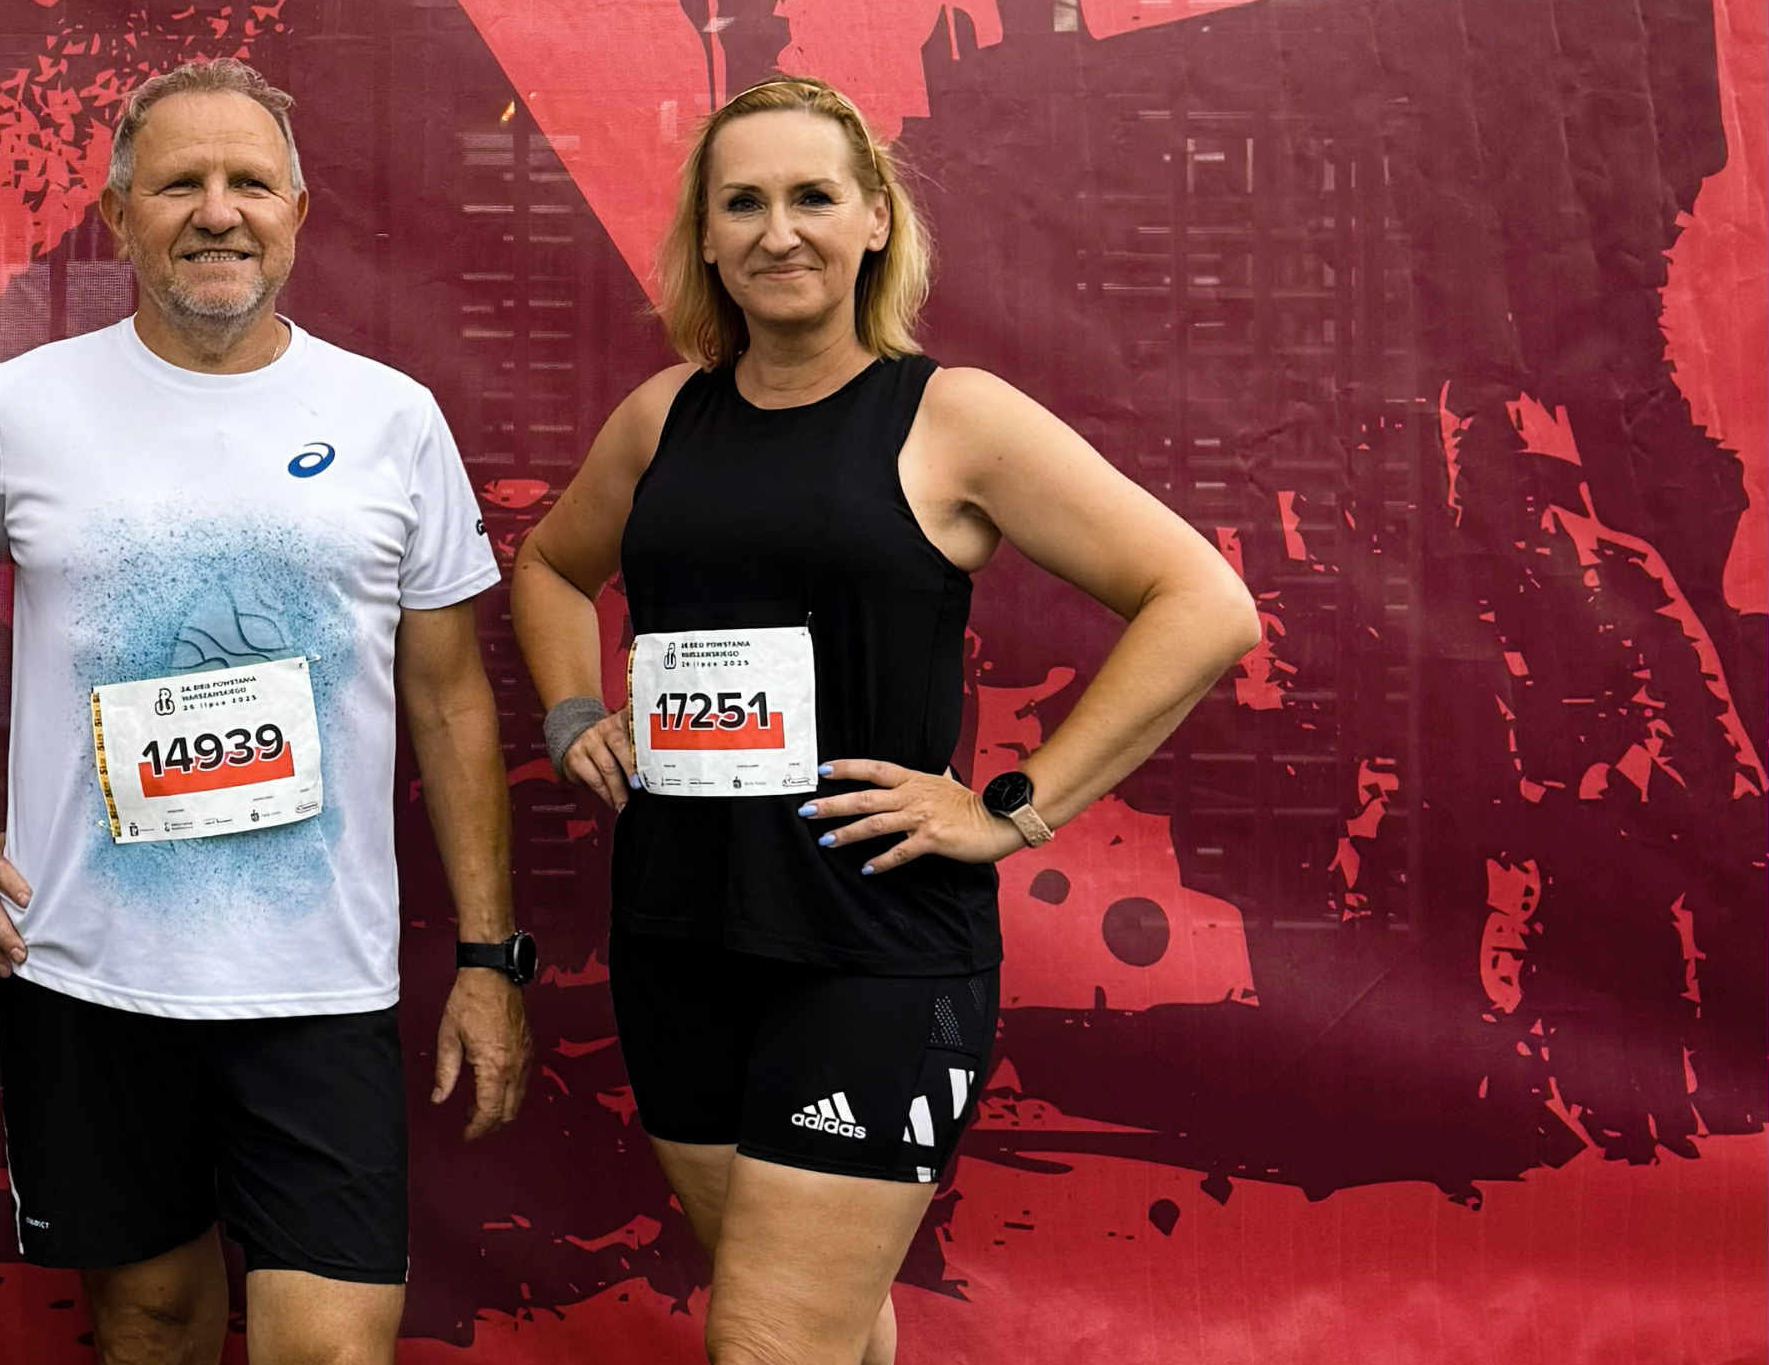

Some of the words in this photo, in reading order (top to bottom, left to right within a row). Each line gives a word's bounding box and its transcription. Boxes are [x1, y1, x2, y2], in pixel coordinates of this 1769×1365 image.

[656, 691, 769, 729] 17251
[141, 723, 284, 776] 14939
[791, 1113, 866, 1139] adidas
